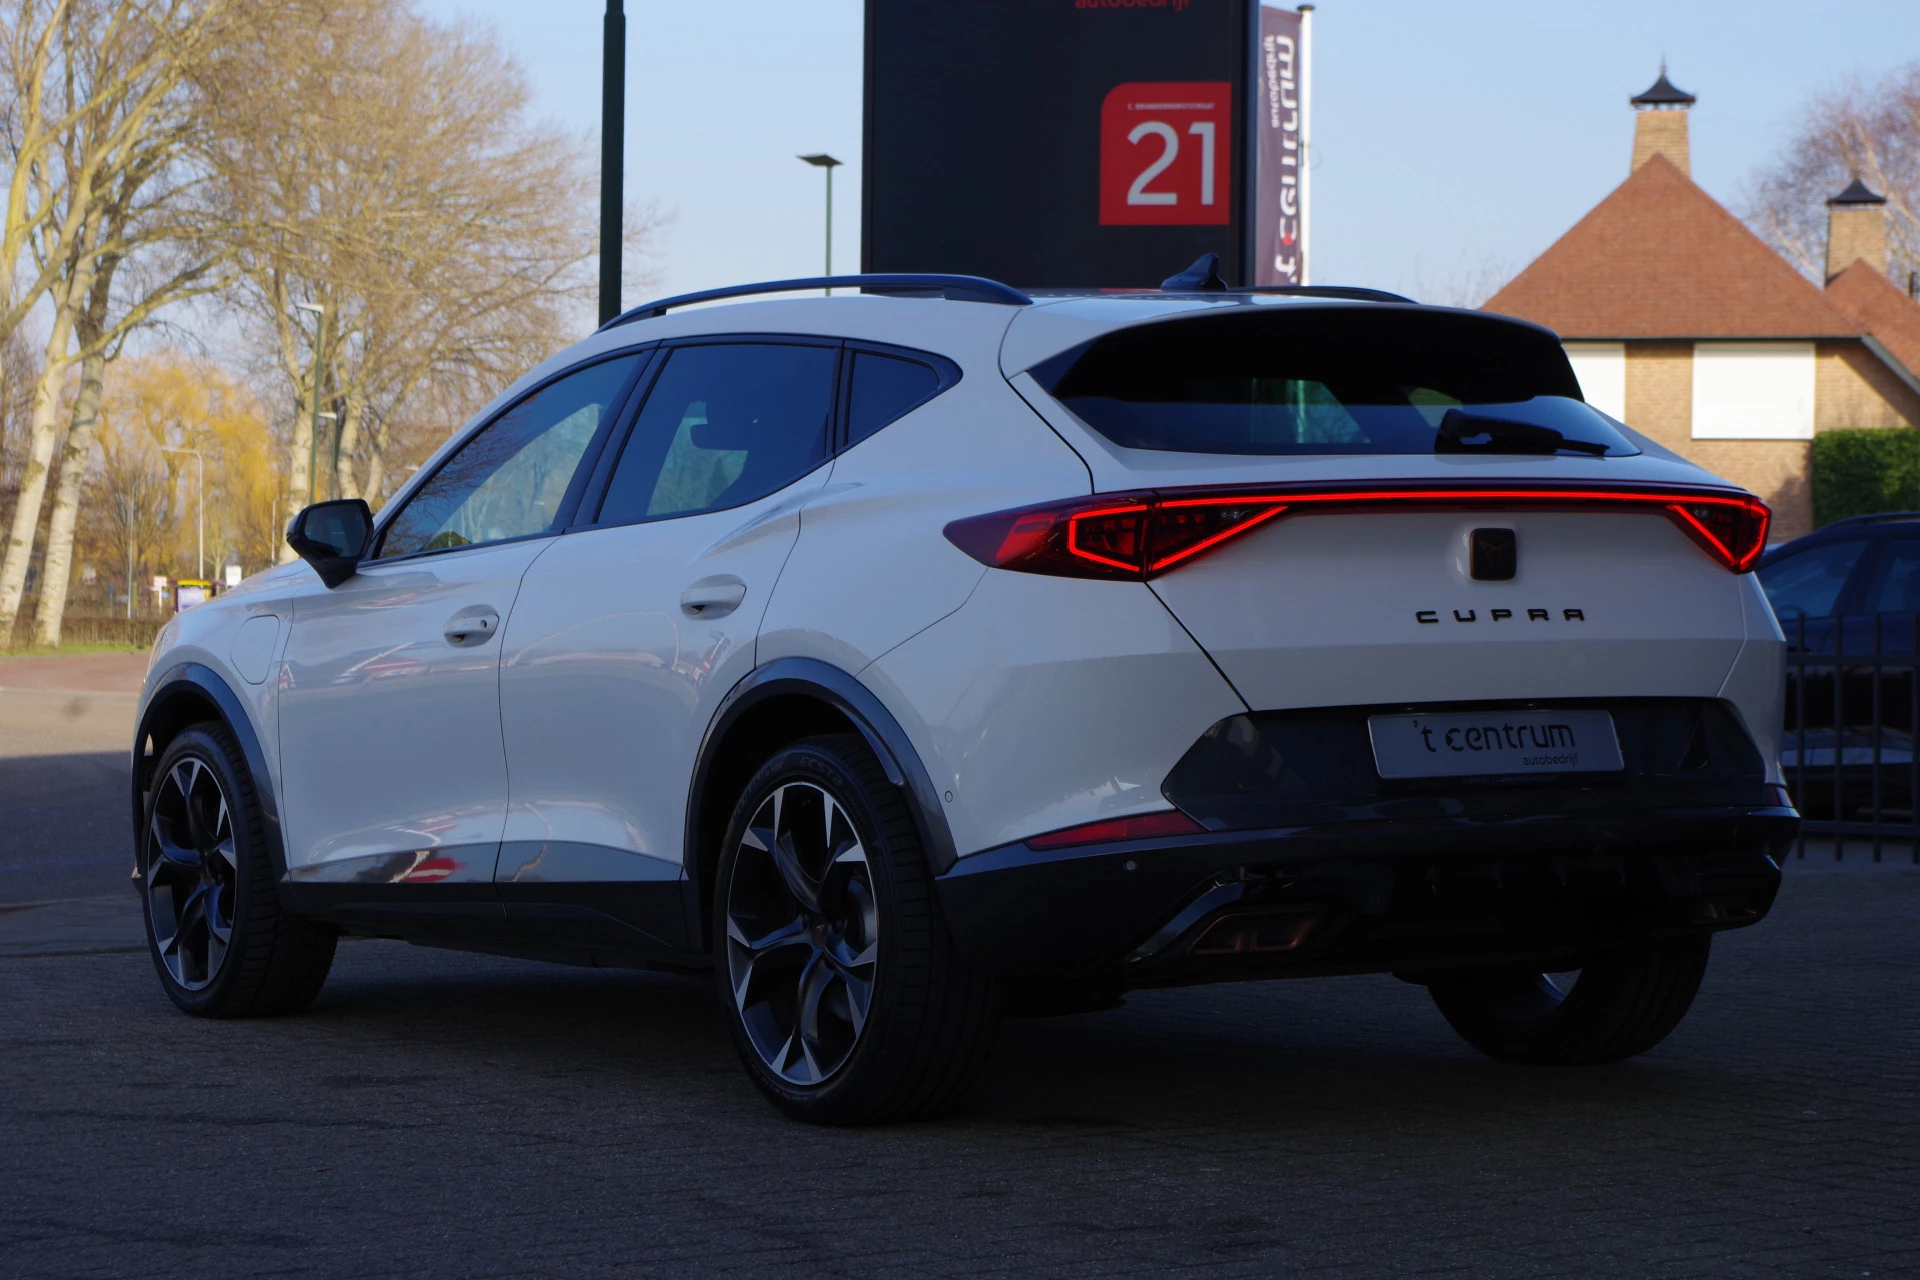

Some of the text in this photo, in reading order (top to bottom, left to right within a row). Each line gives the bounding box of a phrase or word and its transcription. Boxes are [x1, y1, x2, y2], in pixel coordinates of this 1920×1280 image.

[1127, 121, 1215, 206] 21
[1415, 608, 1586, 624] CUPRA
[1413, 719, 1577, 752] 't centrum
[1522, 753, 1579, 768] autobedrijf
